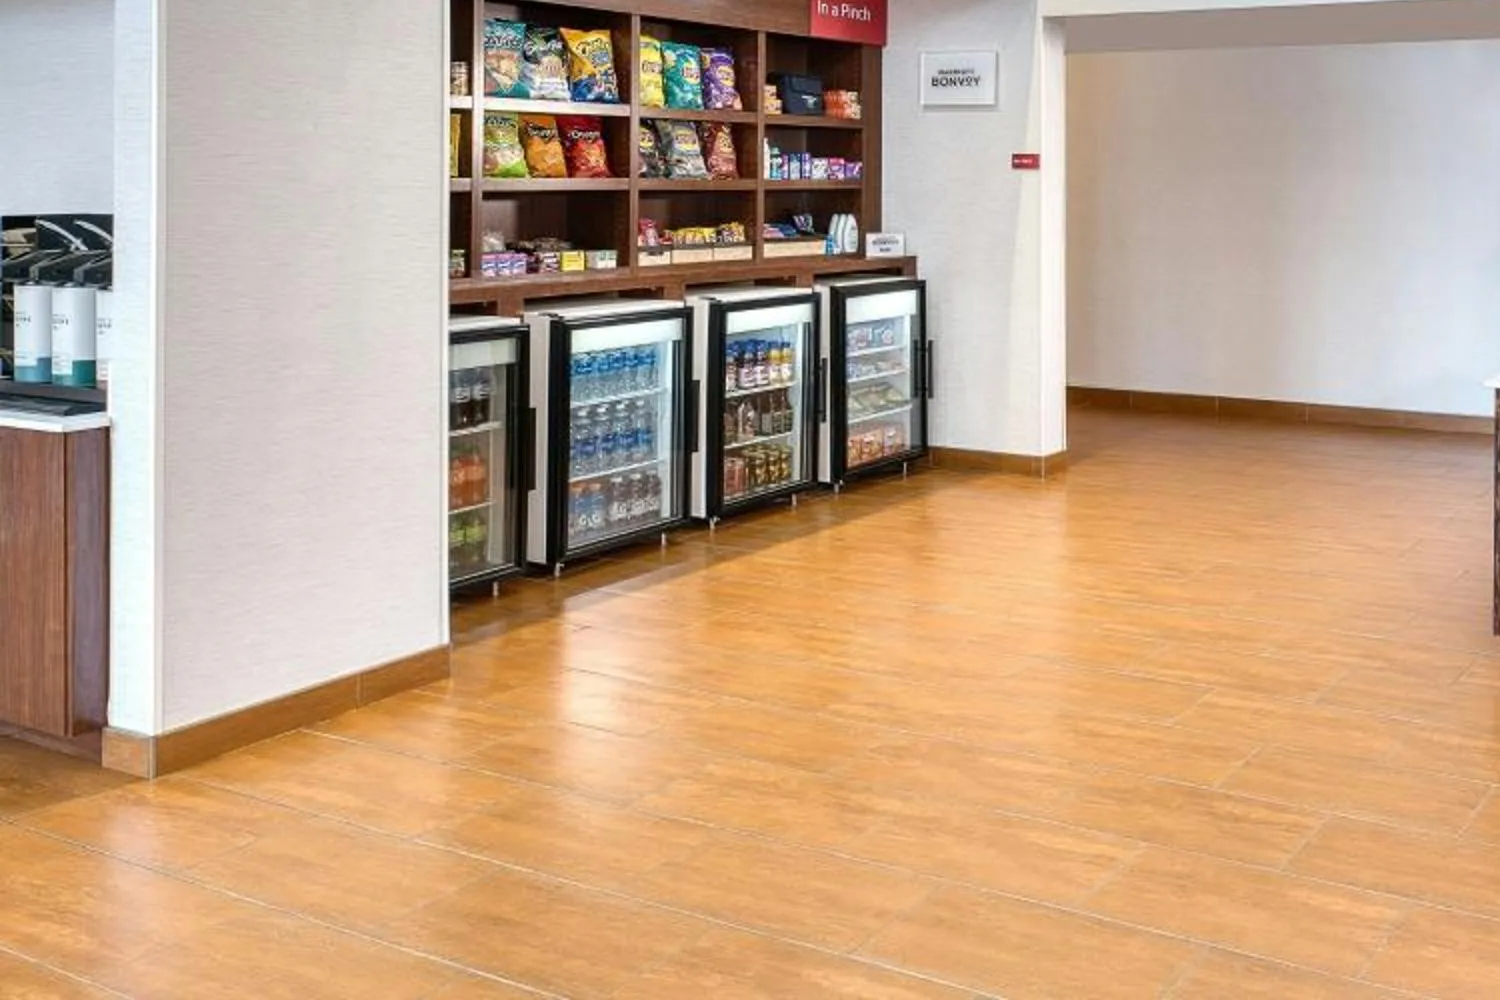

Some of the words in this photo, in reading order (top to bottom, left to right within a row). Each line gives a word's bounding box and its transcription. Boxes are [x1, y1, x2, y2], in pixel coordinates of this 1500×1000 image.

[817, 0, 829, 16] In
[832, 5, 839, 17] a
[841, 3, 871, 21] Pinch
